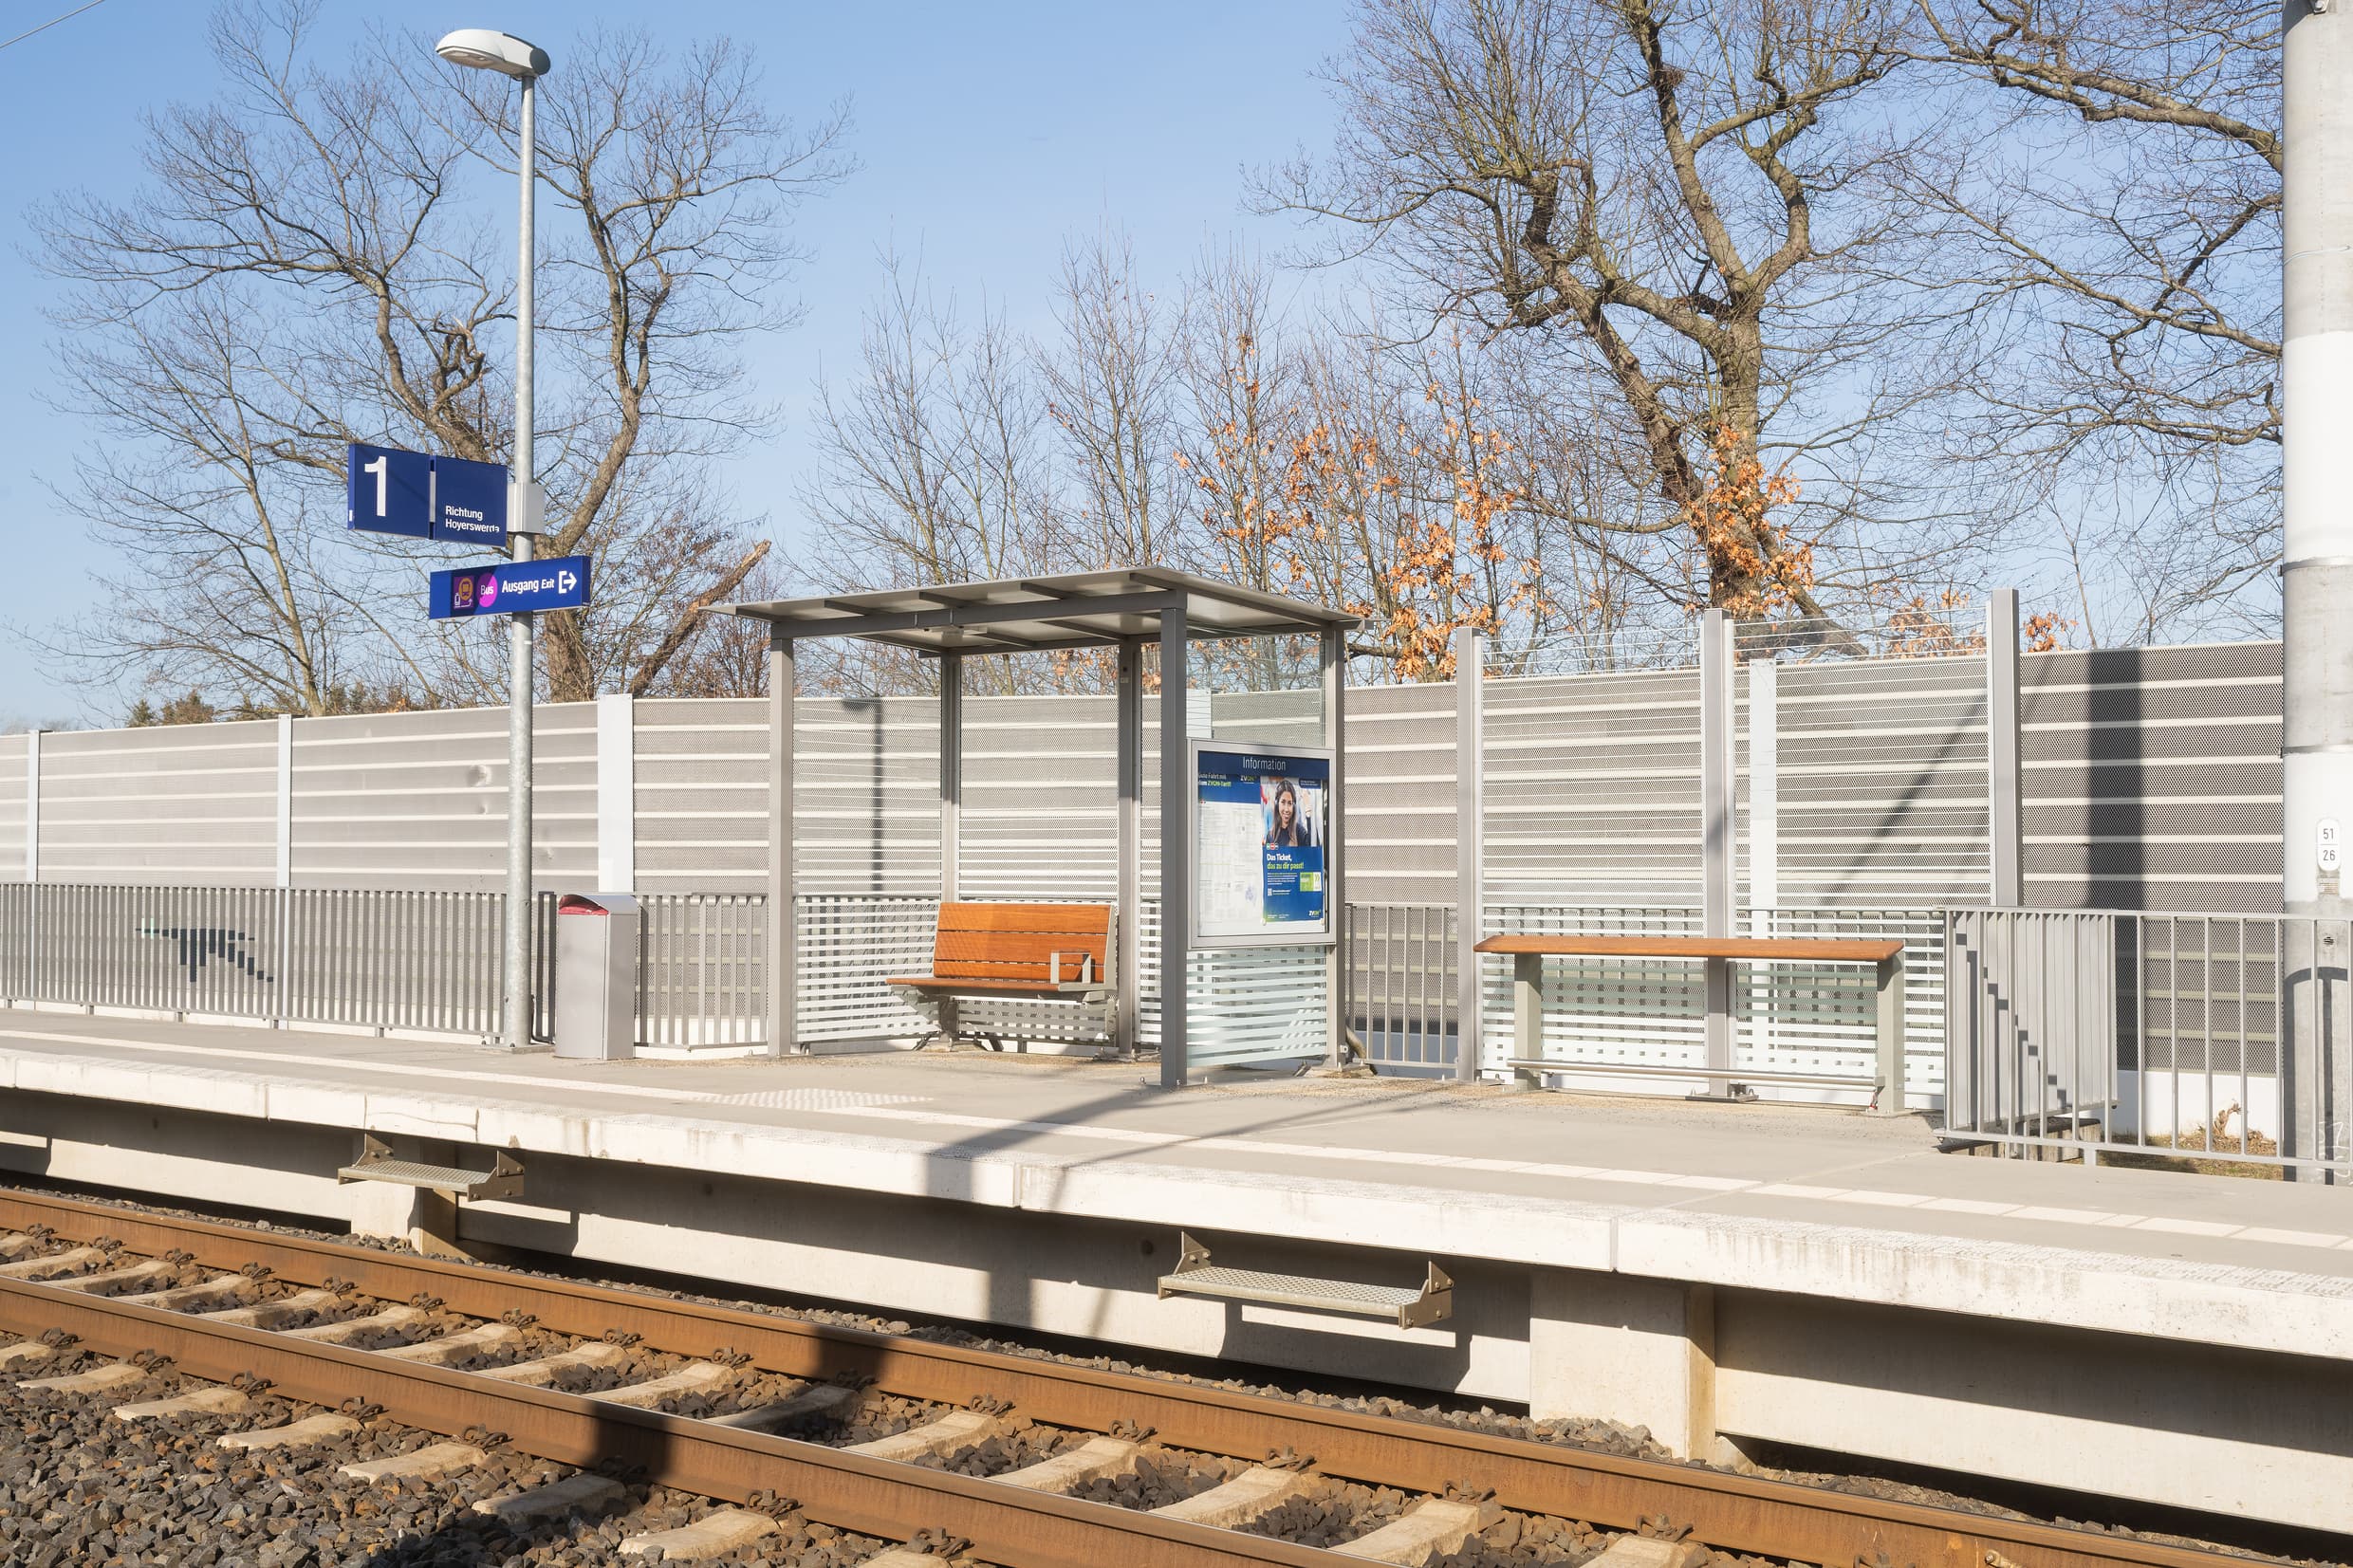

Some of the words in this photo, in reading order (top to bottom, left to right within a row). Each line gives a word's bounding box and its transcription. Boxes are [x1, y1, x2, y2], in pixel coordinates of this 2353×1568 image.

[364, 455, 387, 517] 1
[445, 505, 483, 522] Richtung
[480, 584, 494, 596] Bus
[501, 580, 540, 595] Ausgang
[541, 578, 555, 589] Exit
[1243, 756, 1287, 771] Information
[2323, 828, 2333, 839] 51
[1276, 853, 1292, 861] Ticket,
[2323, 850, 2335, 860] 26
[1290, 861, 1304, 871] passt!
